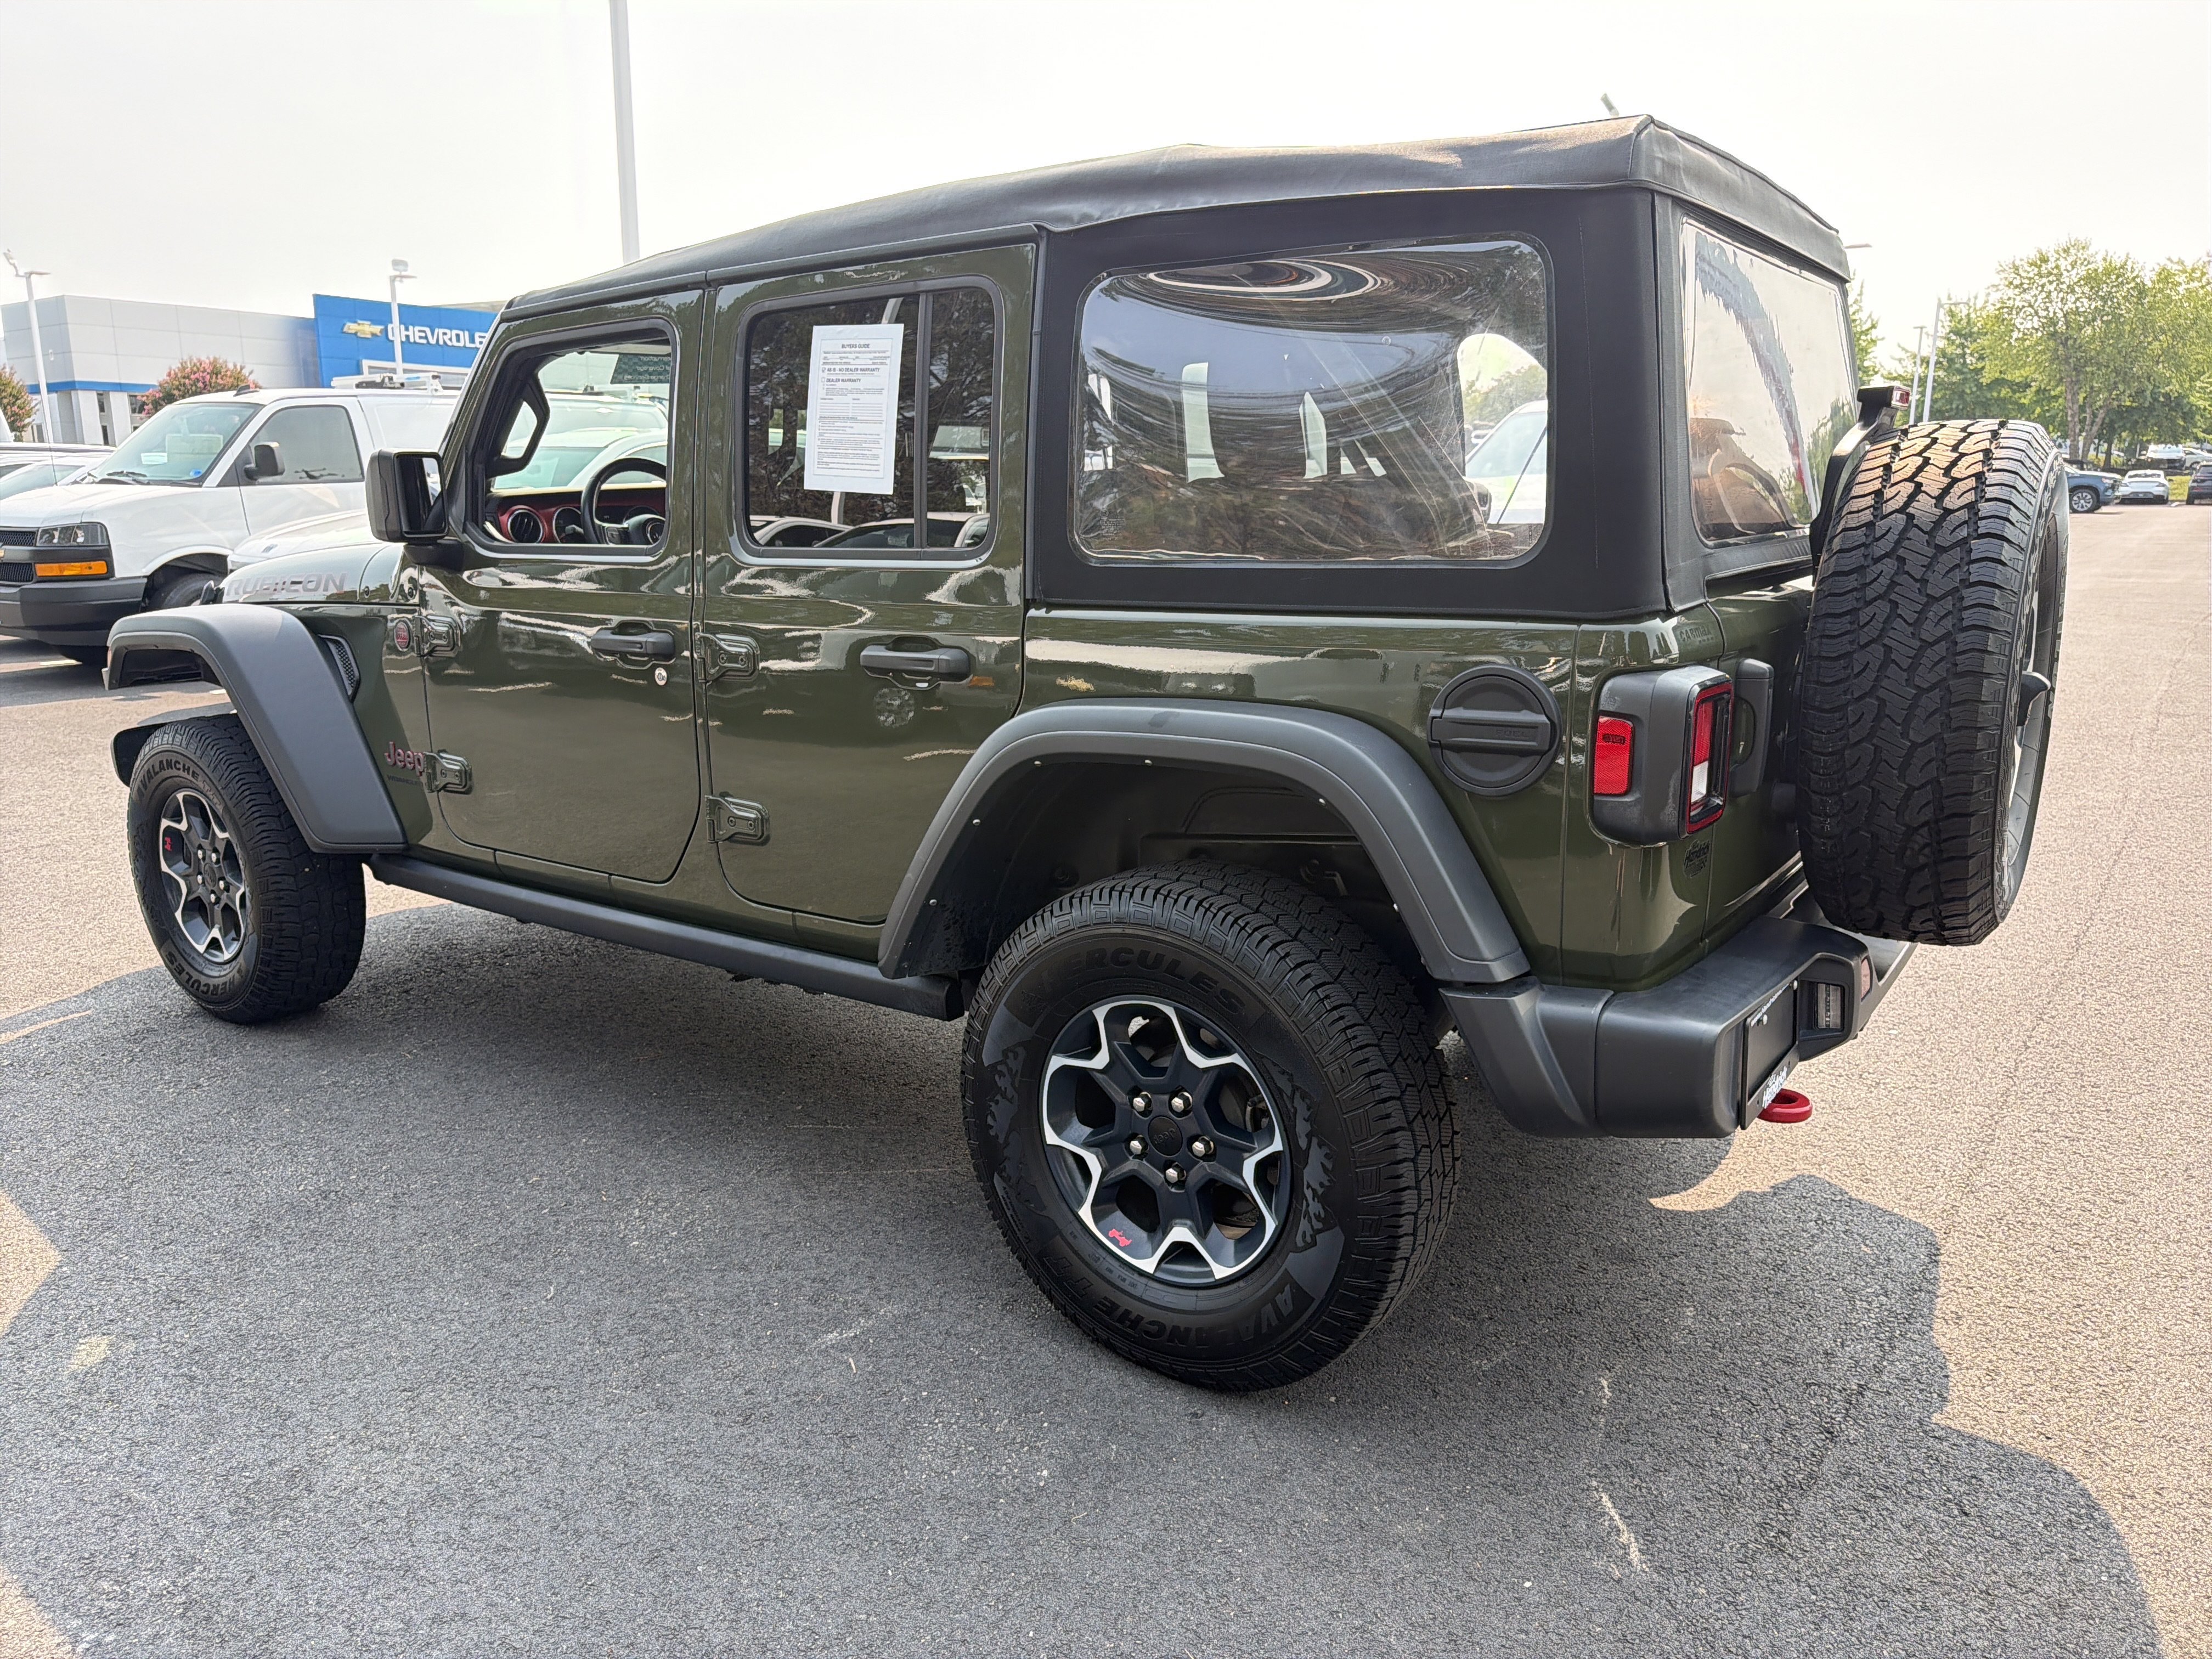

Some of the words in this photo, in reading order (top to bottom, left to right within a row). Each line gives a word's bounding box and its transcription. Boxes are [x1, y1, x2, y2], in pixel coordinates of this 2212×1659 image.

[226, 572, 347, 596] RUBICON
[1496, 728, 1530, 738] FUEL
[138, 759, 200, 798] AVALANCHE
[384, 741, 424, 777] Jeep
[166, 951, 235, 996] HERCULES
[1040, 946, 1246, 1015] HERCULES
[1092, 1284, 1294, 1348] AVALANCHE
